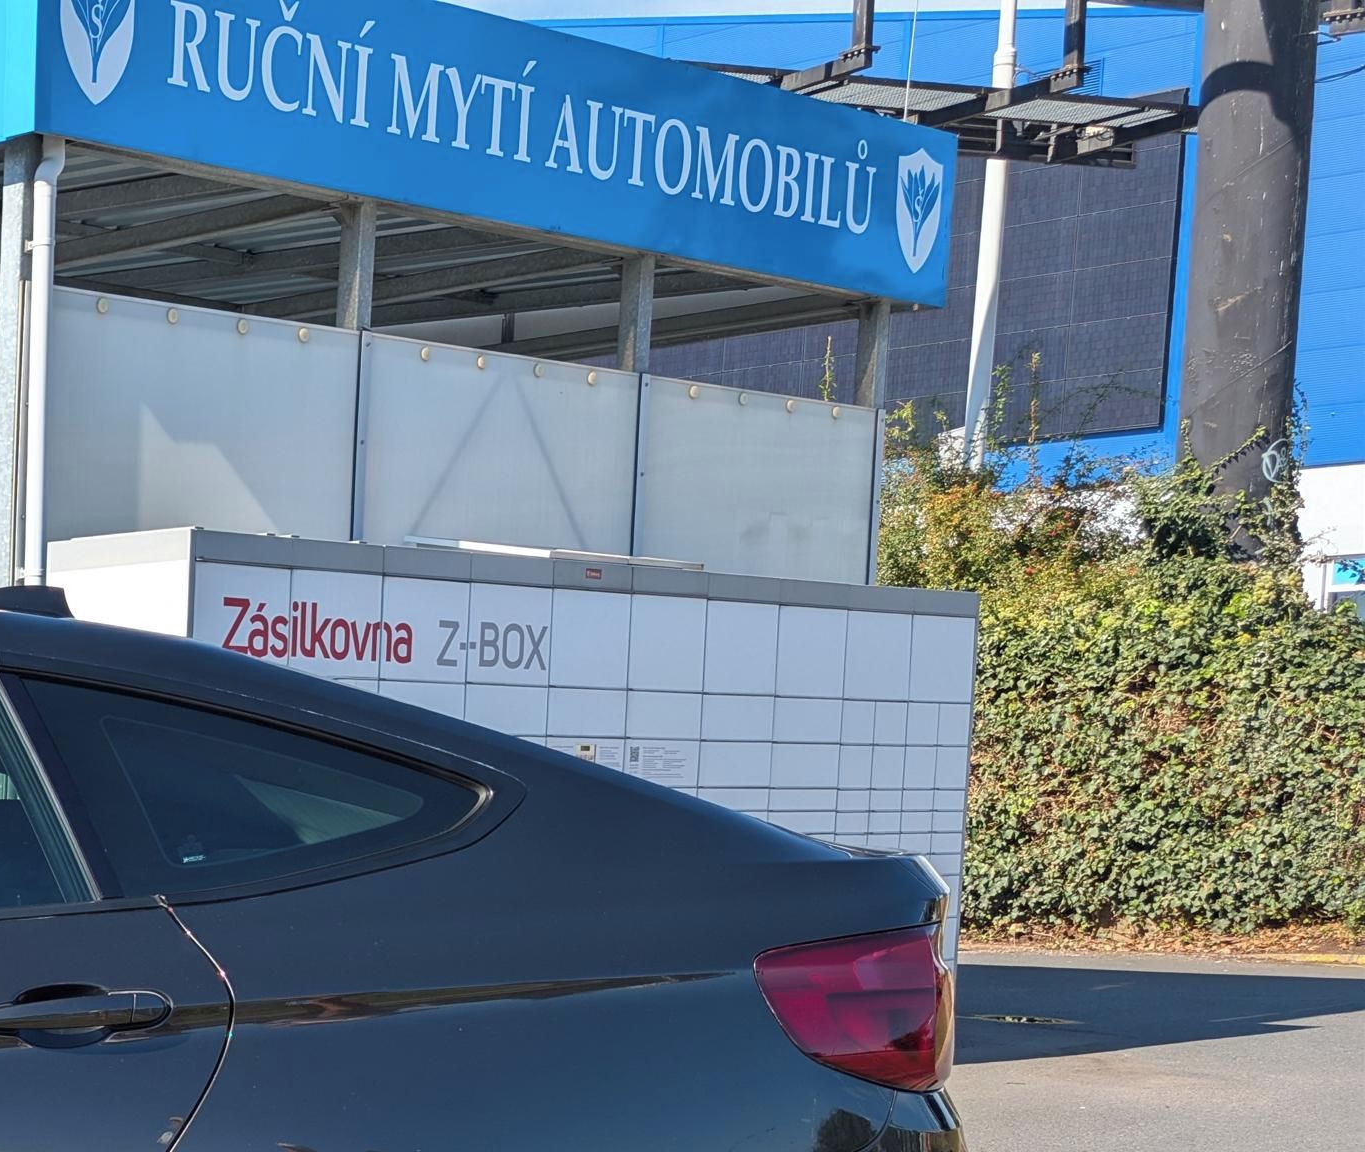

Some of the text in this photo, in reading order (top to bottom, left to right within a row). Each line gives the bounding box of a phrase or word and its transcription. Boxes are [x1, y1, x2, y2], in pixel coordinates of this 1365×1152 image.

[167, 0, 877, 234] RUČNÍ MYTÍ AUTOMOBILŮ
[221, 596, 549, 672] Zásilkovna Z-BOX
